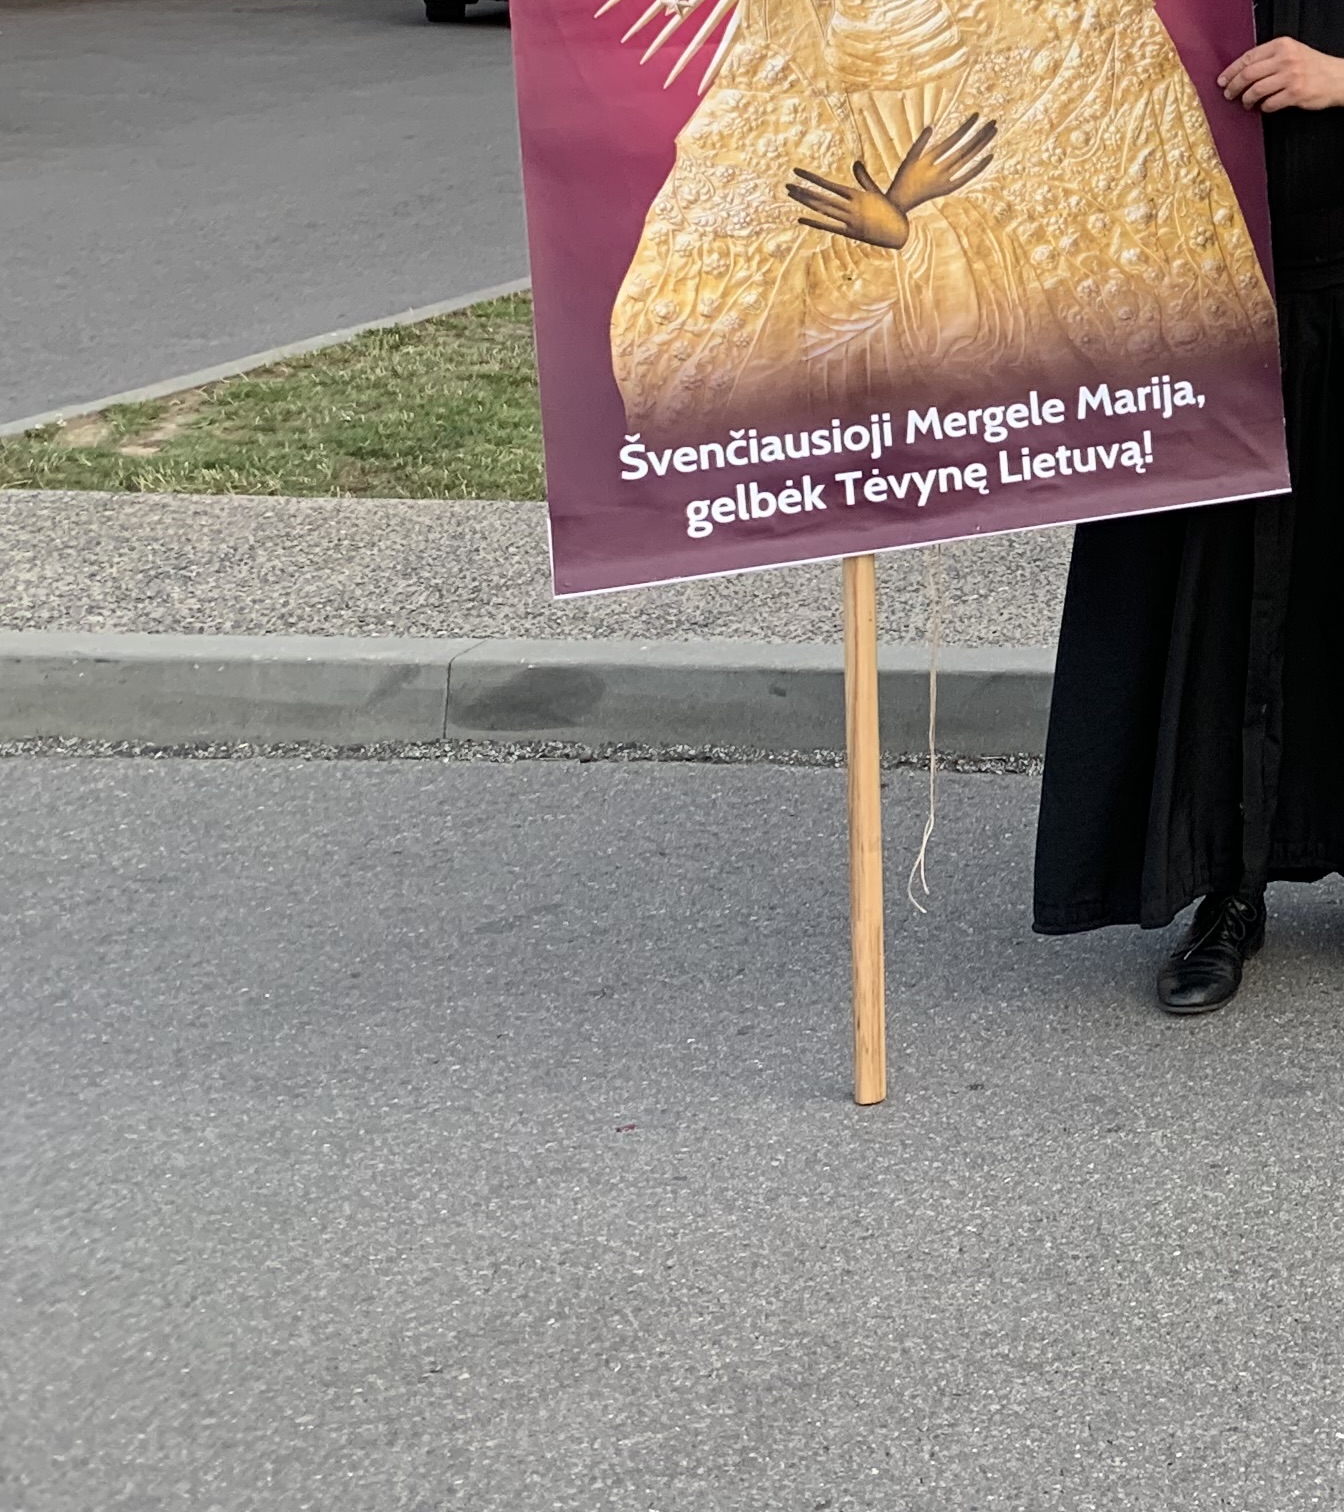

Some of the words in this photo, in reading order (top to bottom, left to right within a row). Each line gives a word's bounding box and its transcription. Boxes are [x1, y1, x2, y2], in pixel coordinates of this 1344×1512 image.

[618, 412, 894, 480] Švenčiausioji
[906, 389, 1066, 446] Mergele
[1077, 373, 1207, 421] Marija,
[685, 475, 828, 539] gelbėk
[833, 462, 990, 507] Tėvynę
[998, 430, 1154, 485] Lietuvą!
